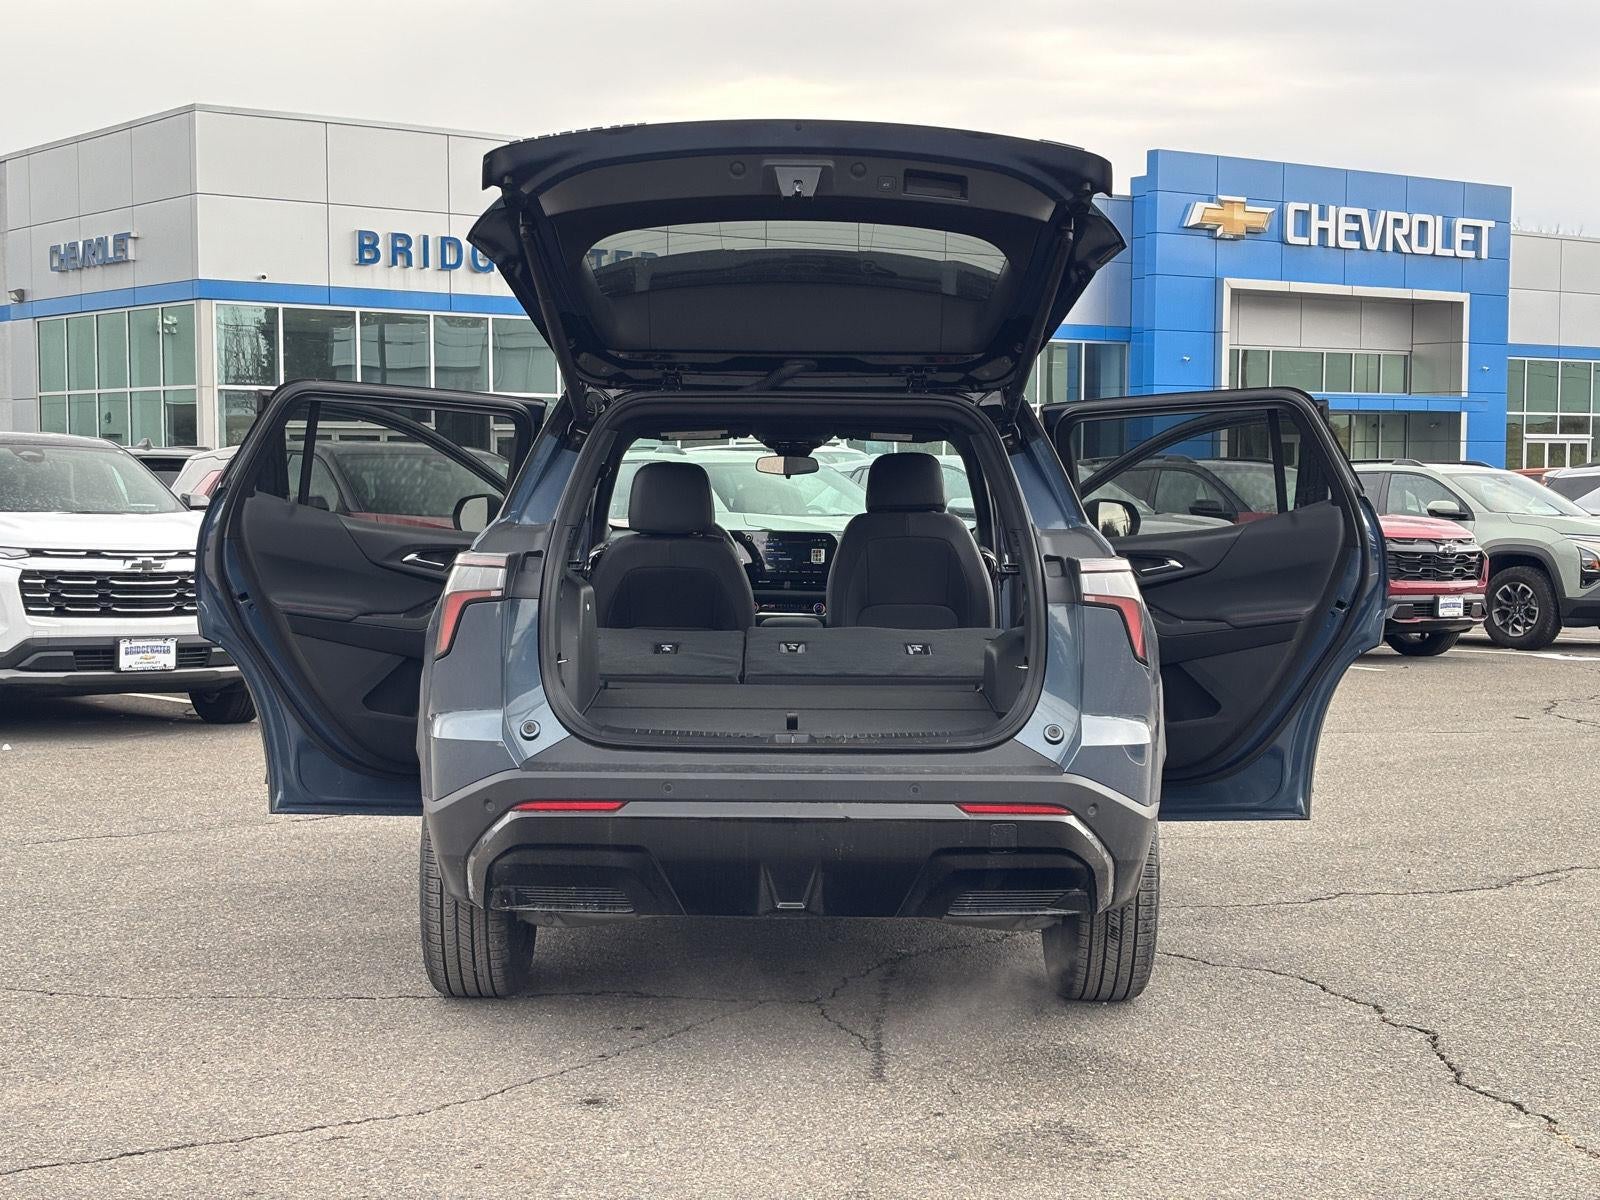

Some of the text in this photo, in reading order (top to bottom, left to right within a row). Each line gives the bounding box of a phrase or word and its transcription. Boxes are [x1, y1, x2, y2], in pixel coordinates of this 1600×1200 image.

[1284, 201, 1496, 260] CHEVROLET
[49, 231, 138, 273] CHEVROLET
[124, 645, 171, 656] BRIDGEWATER
